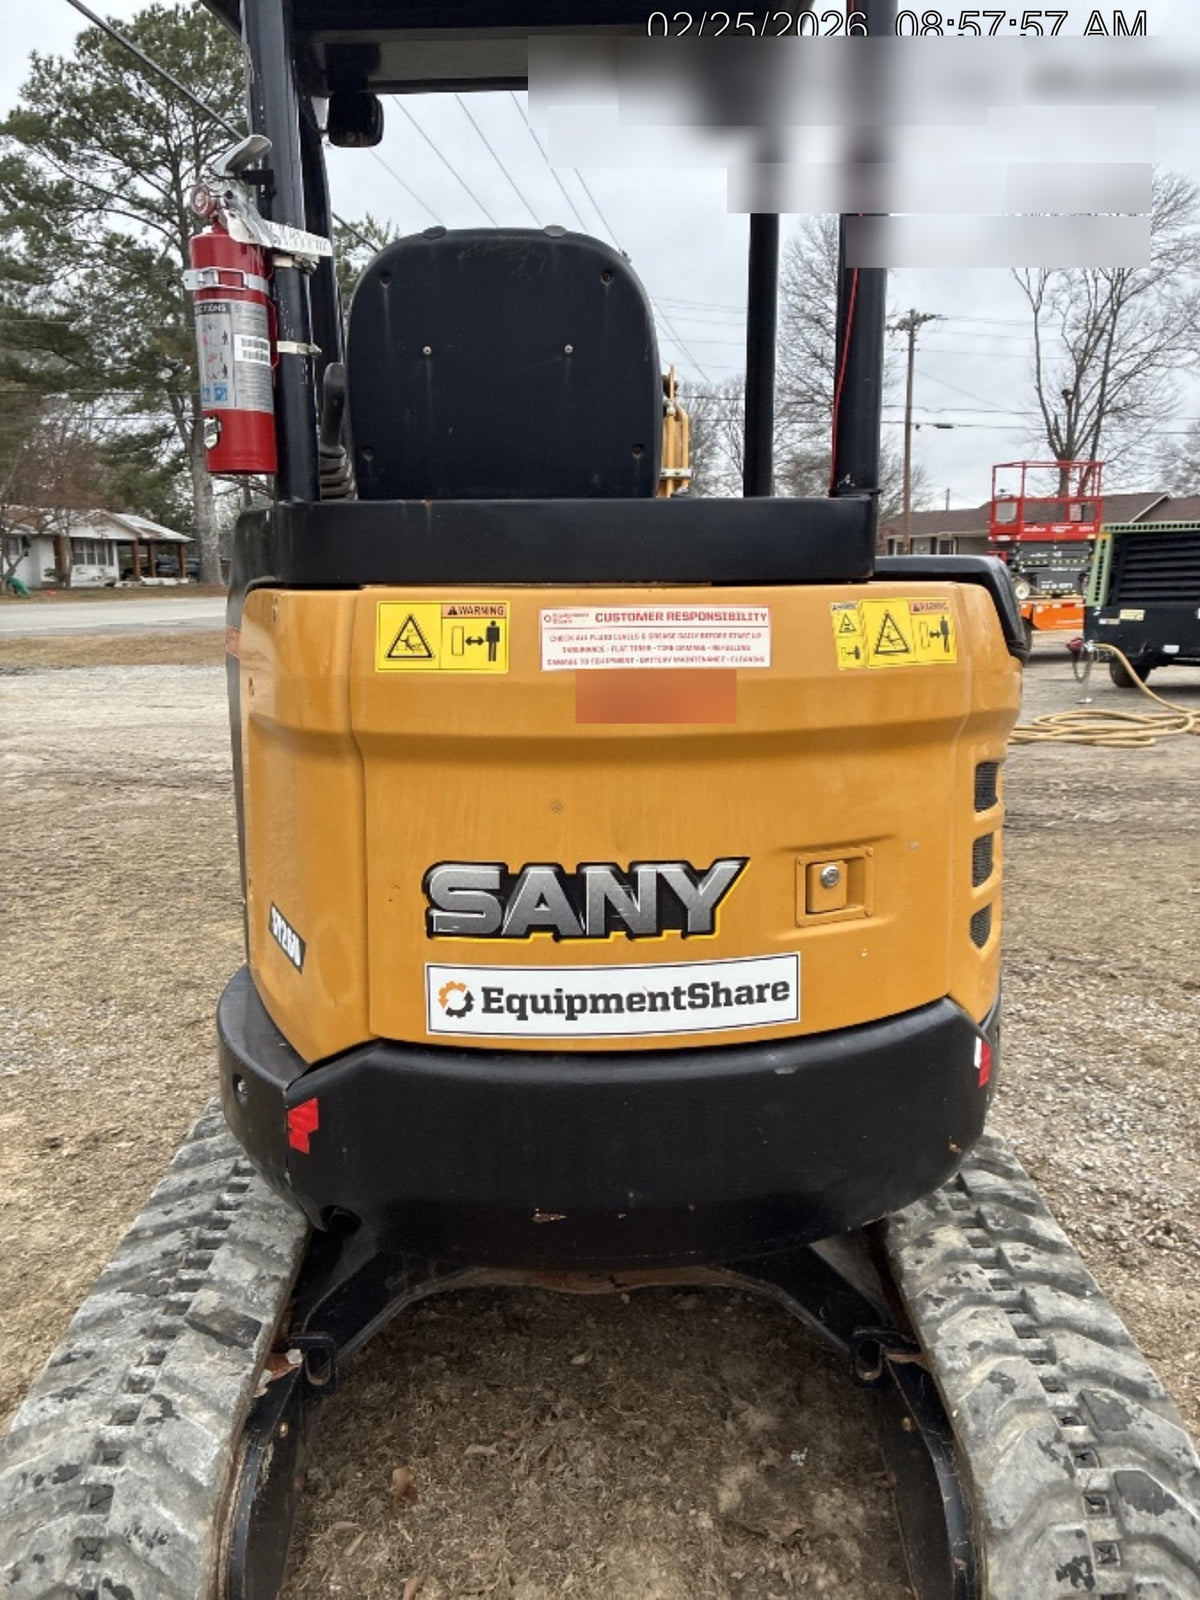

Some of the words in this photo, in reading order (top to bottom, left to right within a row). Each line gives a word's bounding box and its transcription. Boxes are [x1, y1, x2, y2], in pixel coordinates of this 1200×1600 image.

[459, 605, 504, 615] WARNING
[595, 612, 664, 622] CUSTOMER
[666, 611, 767, 621] RESPONSIBILITY
[424, 857, 747, 938] SANY
[481, 980, 790, 1021] EquipmentShare
